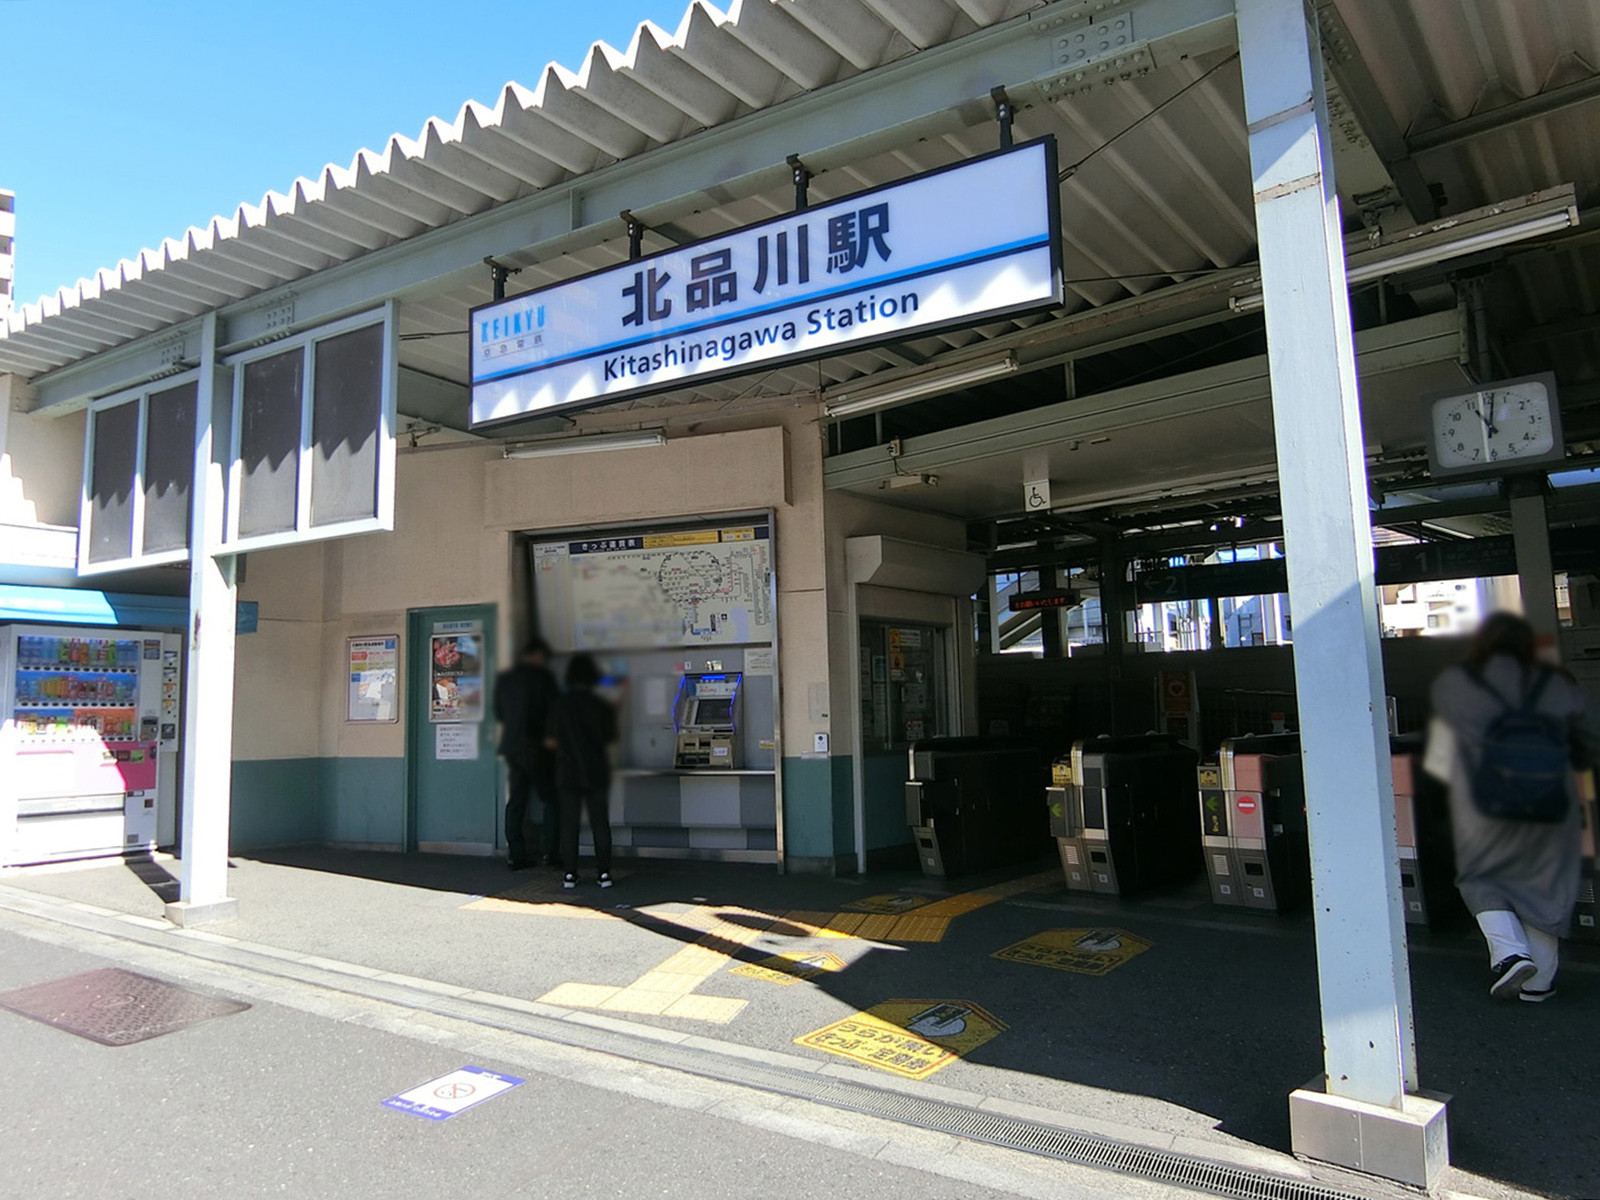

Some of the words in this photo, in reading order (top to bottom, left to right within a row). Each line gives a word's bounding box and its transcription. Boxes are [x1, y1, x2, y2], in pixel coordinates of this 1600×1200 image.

[621, 202, 892, 328] 北品川駅
[481, 304, 545, 343] KEIKYU
[603, 320, 797, 382] Kitashinagawa
[806, 291, 920, 336] Station
[1467, 401, 1476, 411] 11
[1518, 401, 1526, 410] 2
[1452, 412, 1462, 422] 10
[1528, 415, 1536, 425] 3
[1448, 428, 1456, 438] 9
[1522, 432, 1531, 441] 4
[1457, 442, 1465, 452] 8
[1507, 442, 1516, 453] 5
[1472, 448, 1480, 458] 7
[1490, 448, 1499, 458] 6
[1164, 575, 1178, 595] 2
